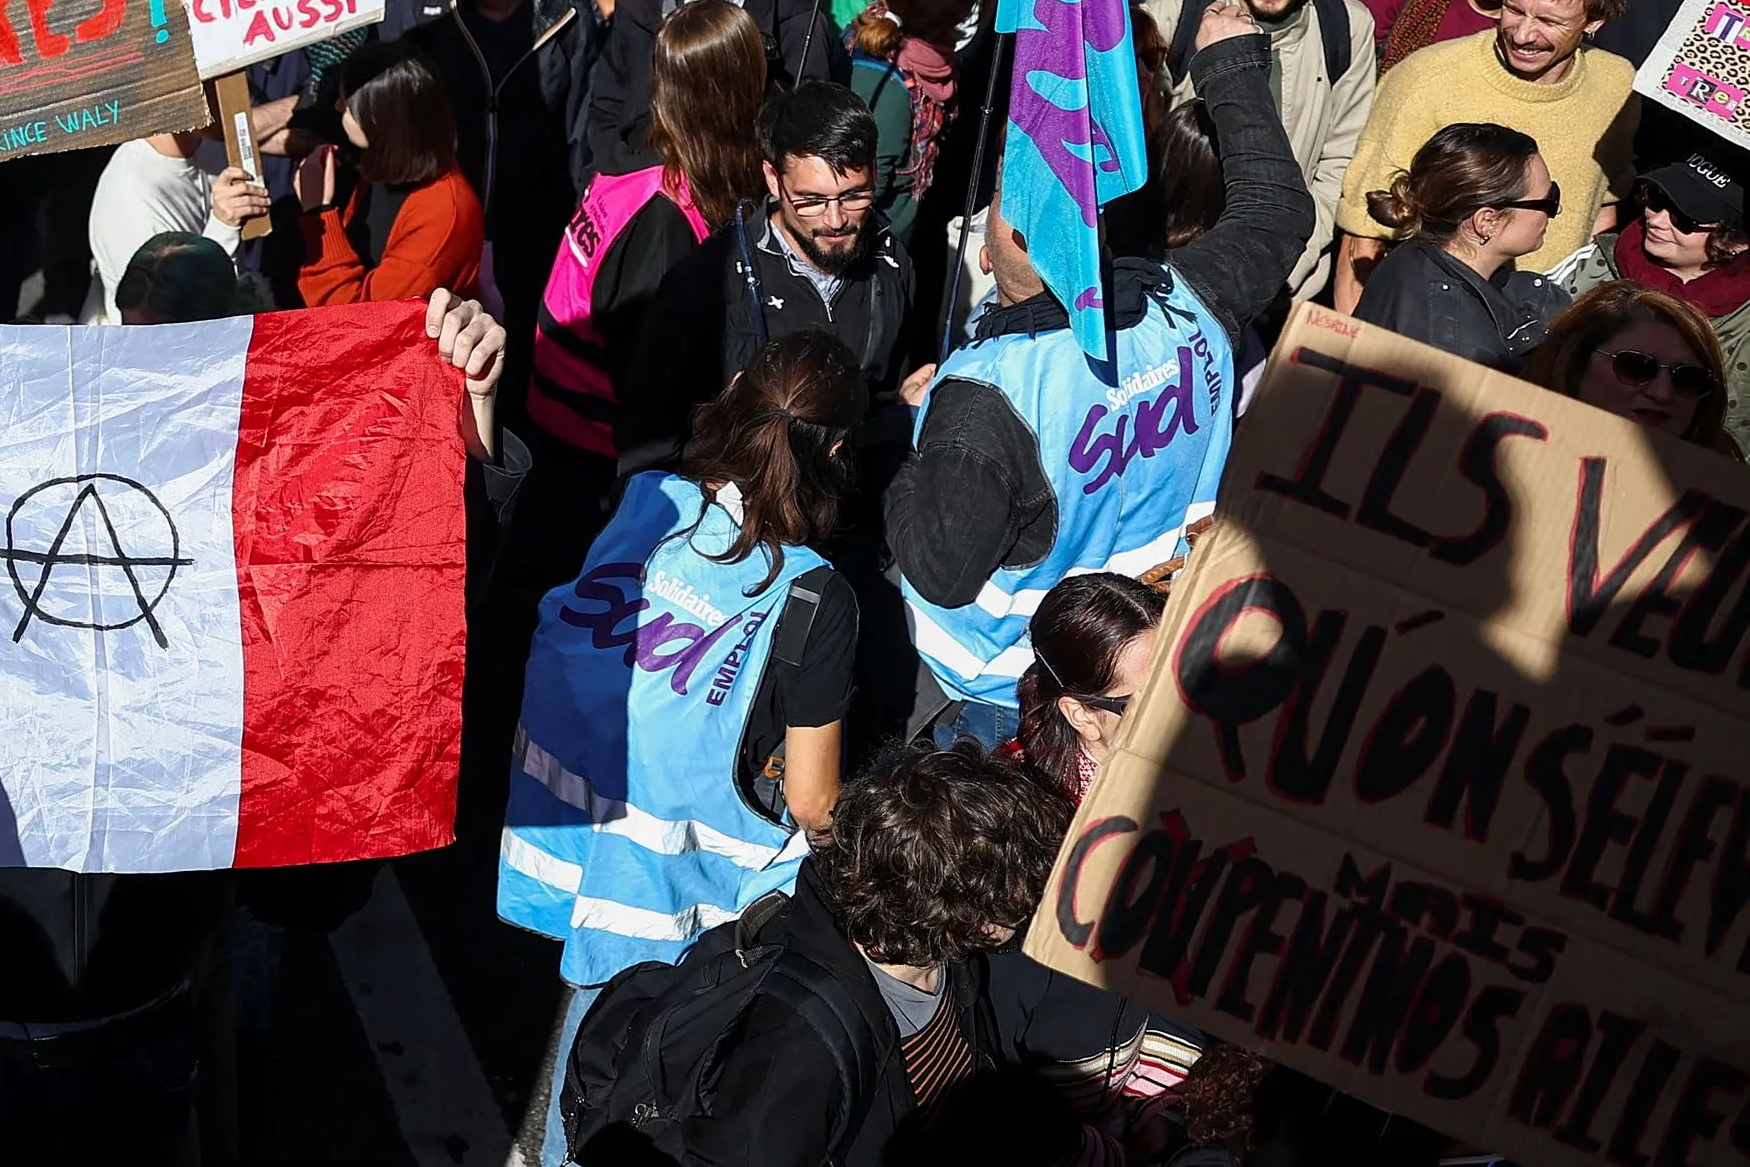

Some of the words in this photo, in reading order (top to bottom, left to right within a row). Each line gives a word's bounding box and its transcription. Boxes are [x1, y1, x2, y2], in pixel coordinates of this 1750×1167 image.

[55, 99, 120, 134] WALY
[1107, 357, 1181, 413] Solidaires
[1253, 345, 1548, 567] ILS
[1567, 456, 1750, 687] VEU
[1333, 852, 1568, 983] MAIS
